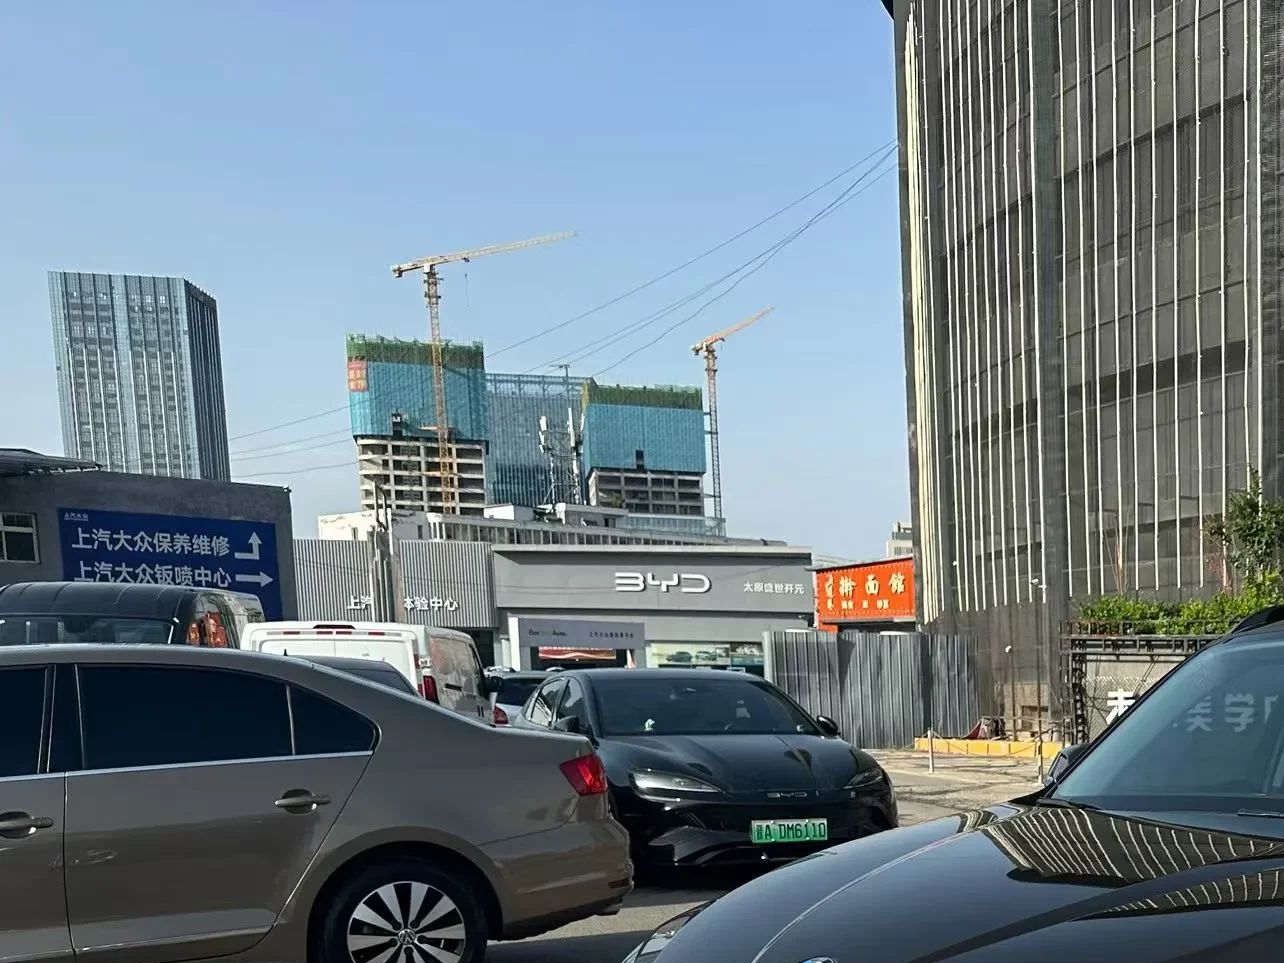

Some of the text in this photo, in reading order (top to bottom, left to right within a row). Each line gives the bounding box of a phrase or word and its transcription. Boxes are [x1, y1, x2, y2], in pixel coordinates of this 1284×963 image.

[71, 527, 231, 557] 上汽大众保养维修
[73, 560, 233, 588] 上汽大众钣喷中心
[615, 572, 712, 593] BYD
[743, 581, 805, 595] 太原盛世开元
